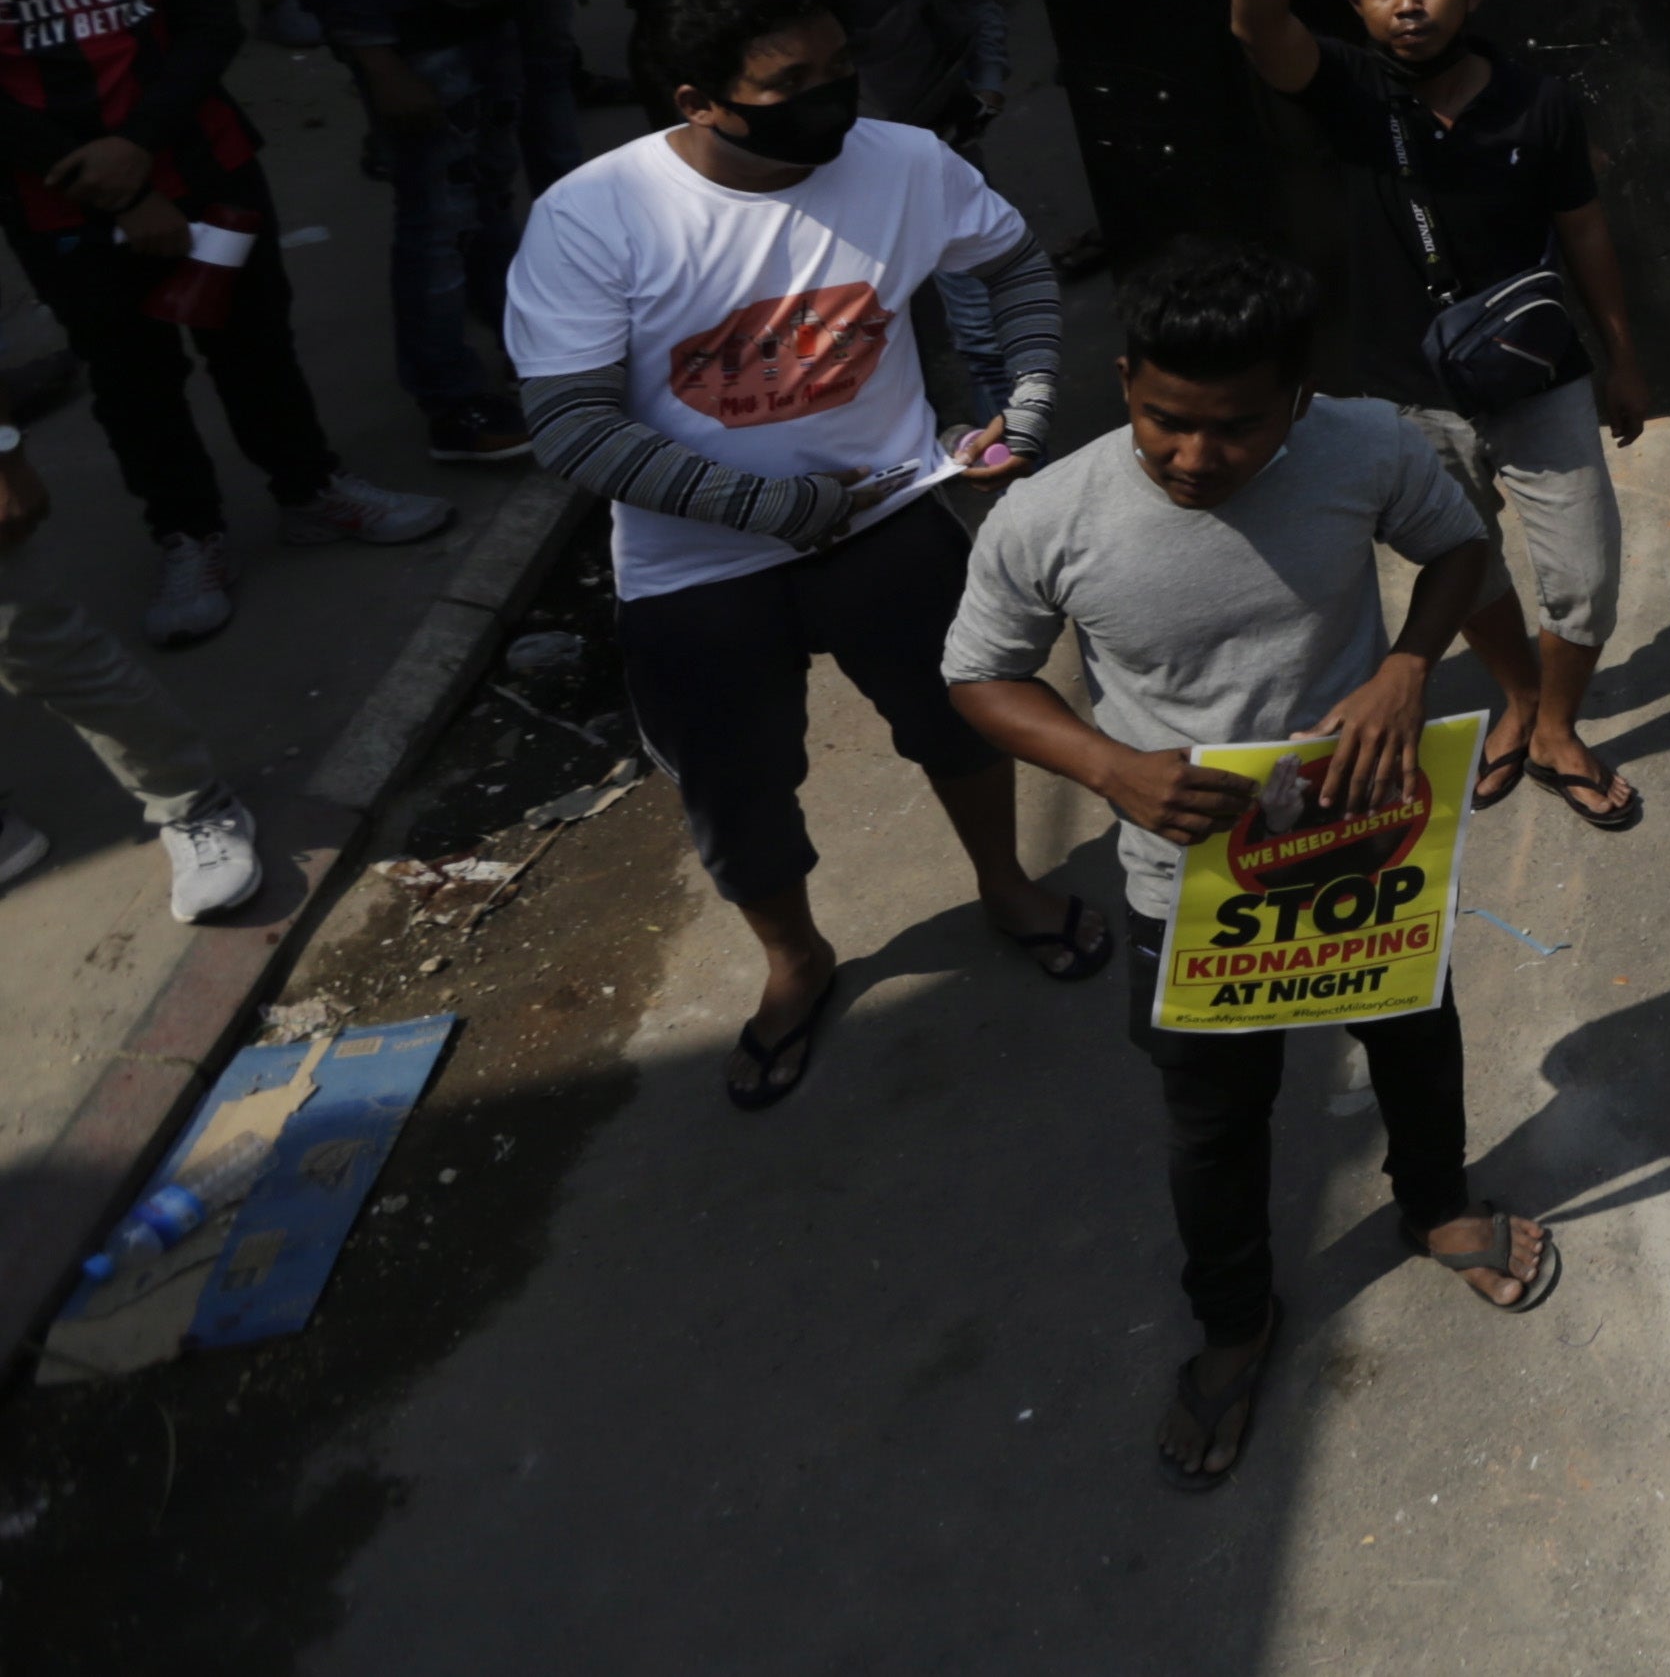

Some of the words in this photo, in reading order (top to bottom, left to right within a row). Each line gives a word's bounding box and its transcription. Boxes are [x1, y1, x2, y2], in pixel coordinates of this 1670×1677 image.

[23, 17, 66, 50] FLY
[1238, 848, 1273, 871] WE
[1279, 829, 1337, 859] NEED
[1341, 799, 1426, 841] JUSTICE
[1210, 865, 1426, 948] STOP
[1186, 923, 1430, 981] KIDNAPPING
[1175, 1010, 1278, 1025] #SaveMyanmar
[1292, 995, 1419, 1019] #RejectMilitaryCoup
[1210, 982, 1262, 1008] AT
[1268, 966, 1389, 1004] NIGHT
